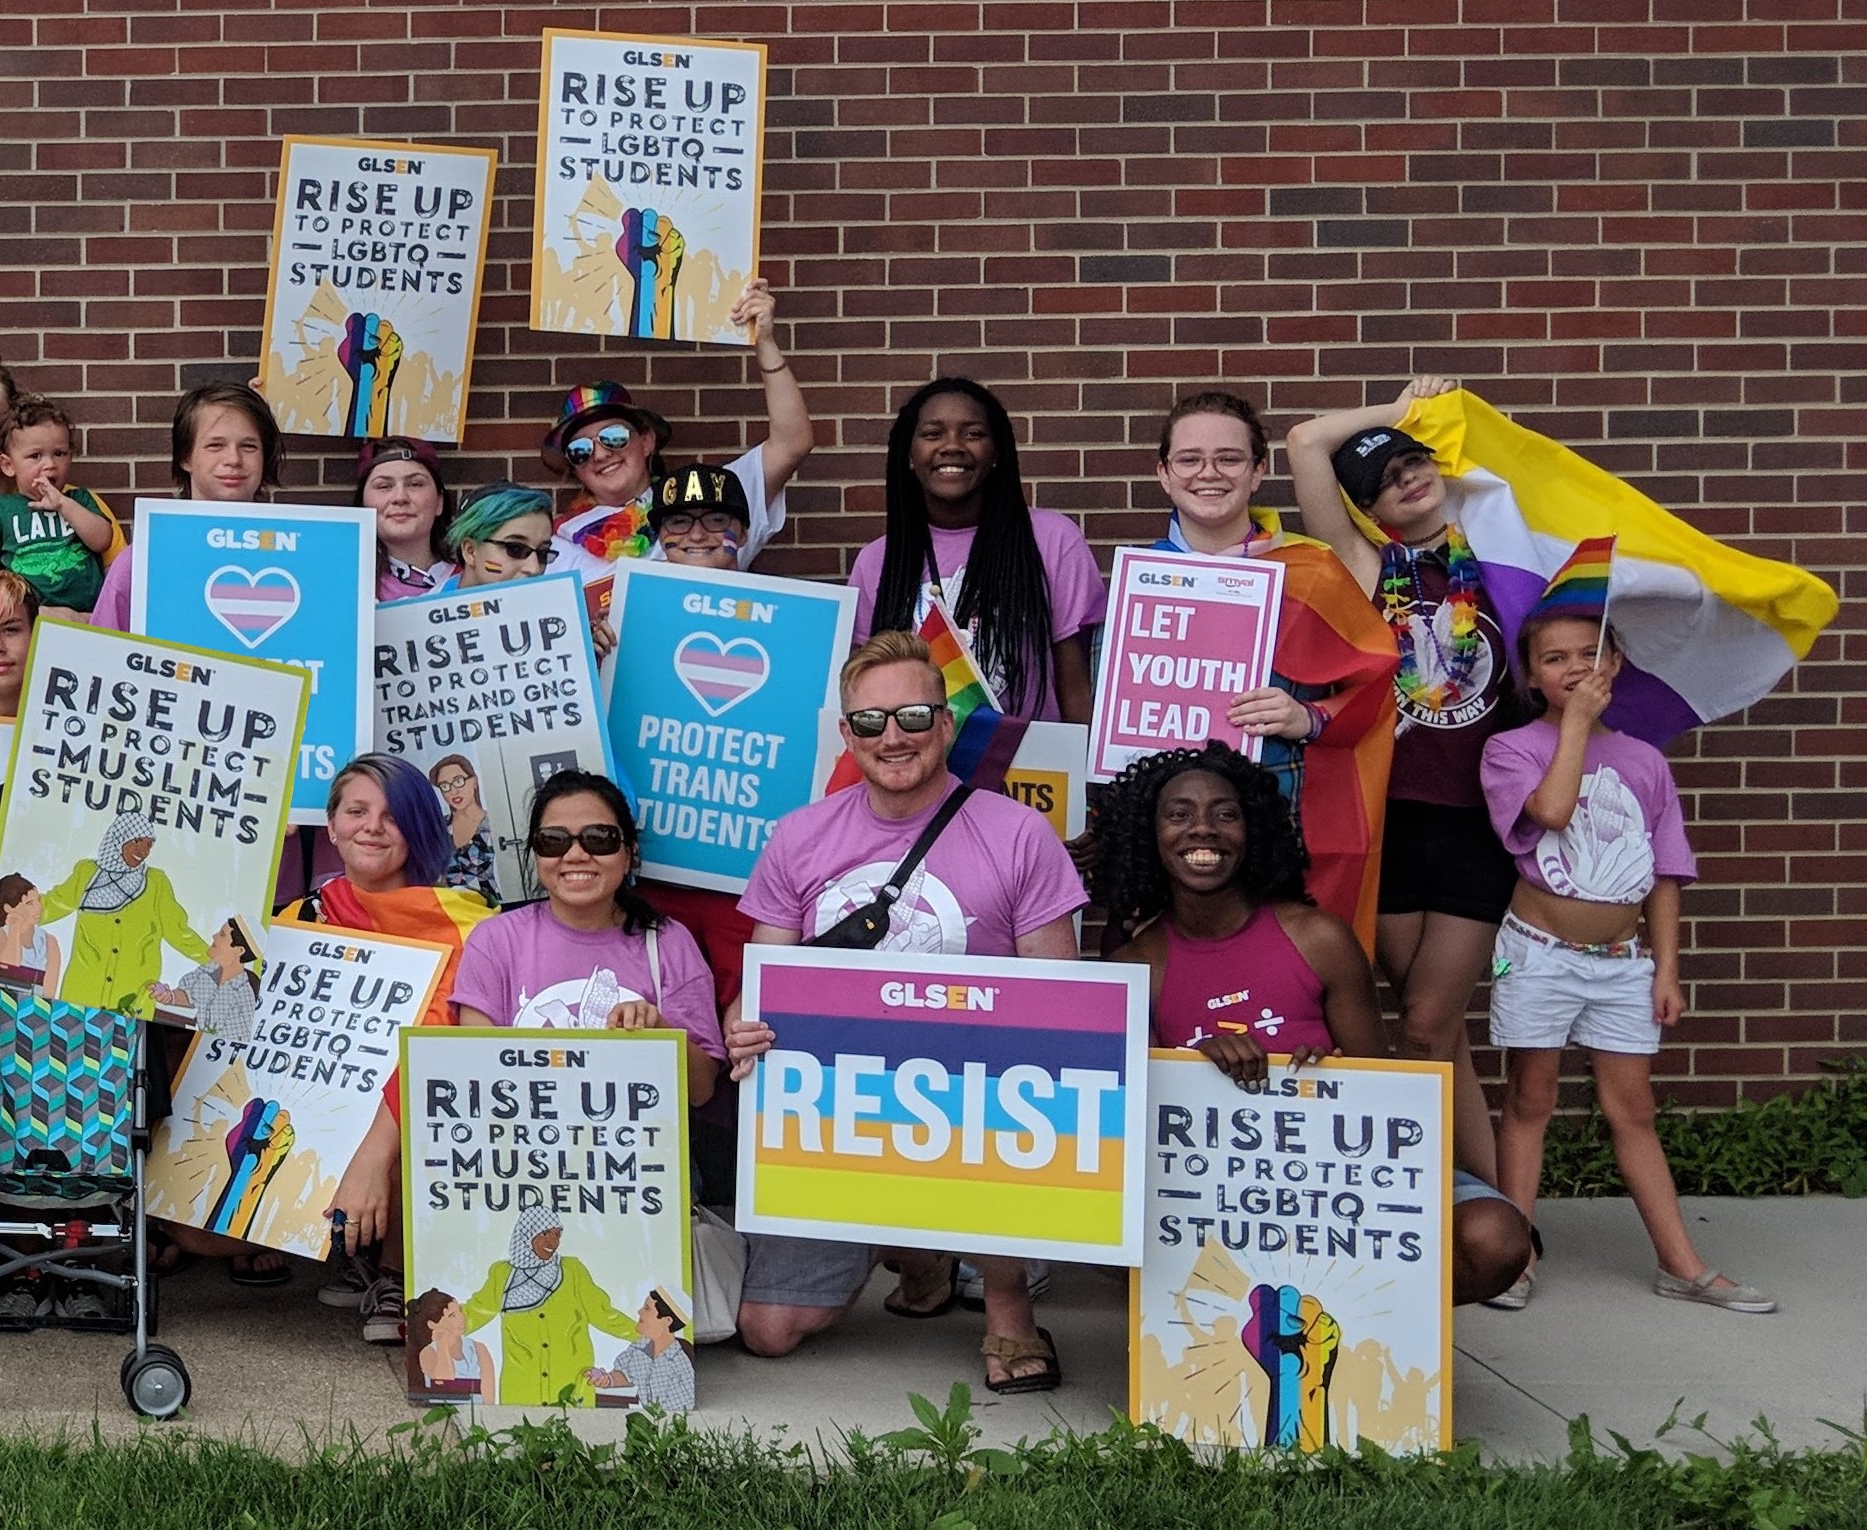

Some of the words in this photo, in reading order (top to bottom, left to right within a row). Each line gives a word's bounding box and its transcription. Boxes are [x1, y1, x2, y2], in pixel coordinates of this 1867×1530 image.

[623, 50, 690, 69] GLSEN
[561, 72, 667, 109] RISE
[685, 80, 746, 114] UP
[561, 108, 598, 126] TO
[610, 111, 746, 136] PROTECT
[358, 157, 422, 175] GLSEN
[602, 133, 704, 164] LGBTQ
[559, 156, 743, 191] STUDENTS
[296, 179, 398, 216] RISE
[414, 186, 473, 219] UP
[295, 215, 329, 233] TO
[341, 218, 470, 241] PROTECT
[332, 239, 429, 269] LGBTQ
[289, 262, 463, 295] STUDENTS
[662, 470, 726, 505] GAY
[13, 512, 74, 543] LATE
[206, 528, 297, 551] GLSEN
[1139, 572, 1194, 588] GLSEN
[428, 599, 500, 624] GLSEN
[683, 593, 774, 624] GLSEN
[1130, 602, 1196, 641] LET
[374, 629, 484, 678] RISE
[499, 616, 567, 657] UP
[126, 652, 212, 687] GLSEN
[376, 679, 416, 701] TO
[429, 654, 572, 693] PROTECT
[1128, 652, 1246, 694] YOUTH
[44, 666, 178, 732] RISE
[198, 699, 277, 748] UP
[382, 696, 459, 725] TRANS
[467, 689, 516, 711] AND
[524, 678, 577, 702] GNC
[1118, 699, 1211, 741] LEAD
[1412, 703, 1449, 724] THIS
[1452, 697, 1486, 724] WAY
[42, 709, 86, 737] TO
[101, 722, 271, 777] PROTECT
[387, 702, 582, 753] STUDENTS
[638, 715, 785, 770] PROTECT
[57, 739, 242, 808] MUSLIM
[649, 758, 760, 809] TRANS
[29, 767, 259, 844] STUDENTS
[638, 798, 779, 850] TUDENTS
[308, 941, 372, 965] GLSEN
[261, 959, 341, 1003] ISE
[350, 974, 414, 1013] UP
[880, 981, 995, 1012] GLSEN
[1207, 990, 1249, 1010] GLSEN
[271, 999, 401, 1037] PROTECT
[254, 1019, 351, 1061] LGBTQ
[499, 1048, 586, 1068] GLSEN
[205, 1038, 379, 1093] STUDENTS
[426, 1079, 558, 1120] RISE
[581, 1081, 660, 1121] UP
[761, 1049, 1119, 1173] RESIST
[427, 1122, 473, 1144] TO
[489, 1124, 661, 1147] PROTECT
[1157, 1104, 1306, 1154] RISE
[1332, 1114, 1424, 1159] UP
[451, 1148, 637, 1181] MUSLIM
[1157, 1152, 1209, 1176] TO
[1227, 1157, 1423, 1189] PROTECT
[429, 1181, 663, 1215] STUDENTS
[1216, 1184, 1365, 1226] LGBTQ
[1158, 1215, 1422, 1262] STUDENTS
